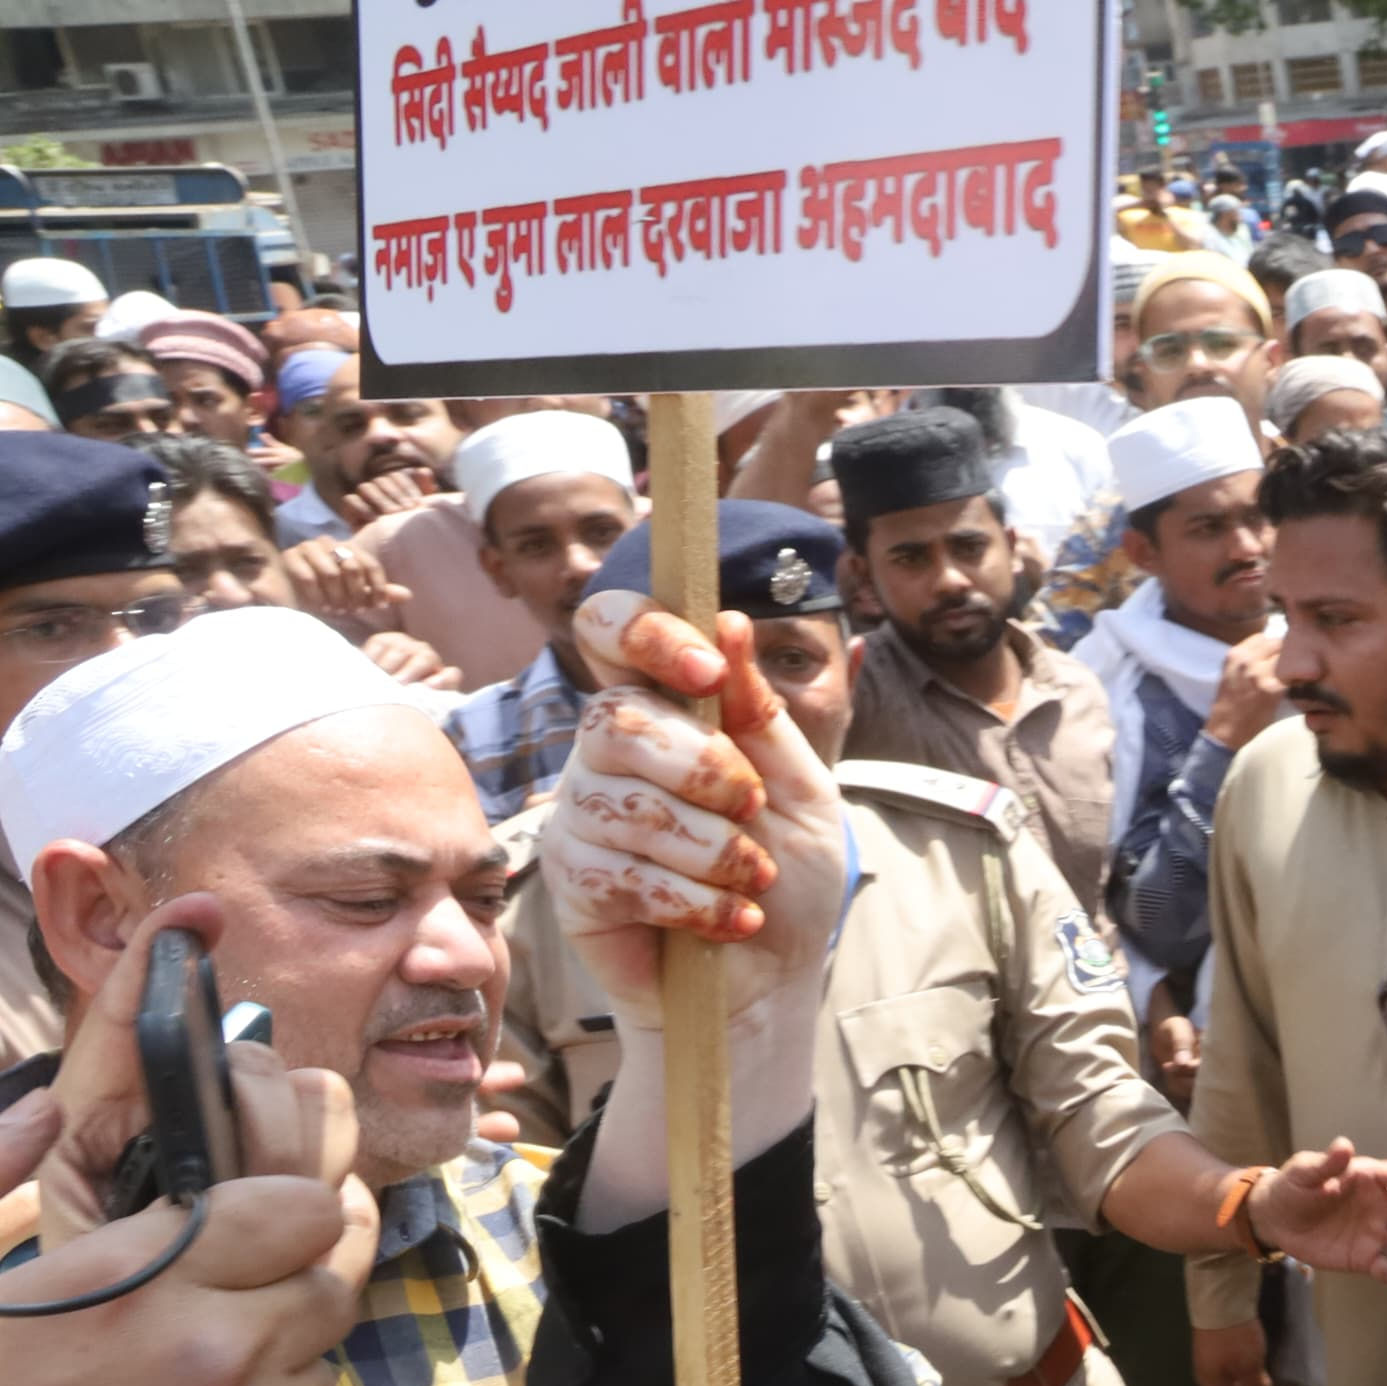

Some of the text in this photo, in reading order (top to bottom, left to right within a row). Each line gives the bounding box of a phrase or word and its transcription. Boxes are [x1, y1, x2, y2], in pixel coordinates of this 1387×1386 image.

[655, 0, 754, 95] वाला
[372, 137, 1062, 314] नमाज़ ए जुमा लाल दरवाजा अहमदाबाद
